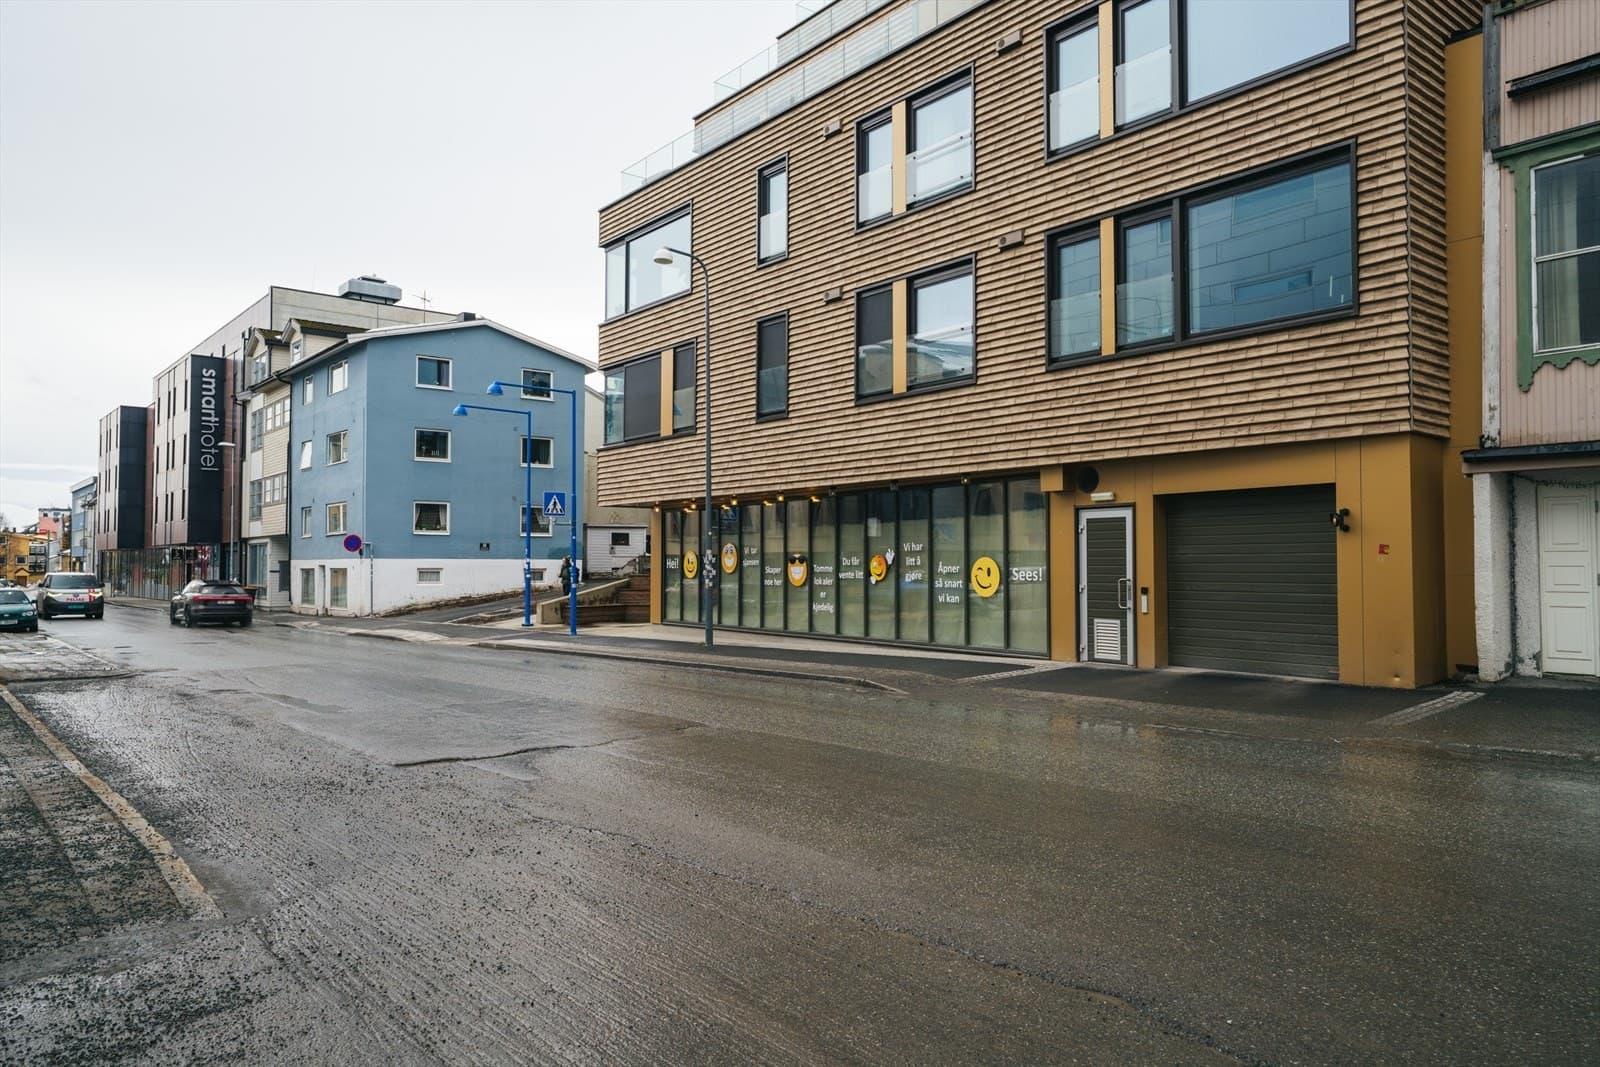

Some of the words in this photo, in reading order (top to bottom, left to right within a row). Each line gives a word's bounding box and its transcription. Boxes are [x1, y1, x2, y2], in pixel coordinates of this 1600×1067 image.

[200, 367, 219, 471] smarthotel
[903, 542, 911, 551] Vi
[911, 542, 923, 551] har
[666, 557, 679, 569] Hei!
[842, 557, 850, 566] Du
[851, 556, 860, 566] får
[905, 556, 915, 566] litt
[813, 564, 833, 573] Tomme
[937, 561, 960, 575] Åpner
[839, 571, 855, 579] vente
[855, 570, 864, 579] litt
[905, 571, 922, 582] gjøre
[1012, 567, 1042, 581] Sees!
[935, 578, 943, 588] så
[944, 579, 963, 589] snart
[820, 591, 826, 599] er
[938, 593, 945, 603] vi
[946, 593, 960, 603] kan
